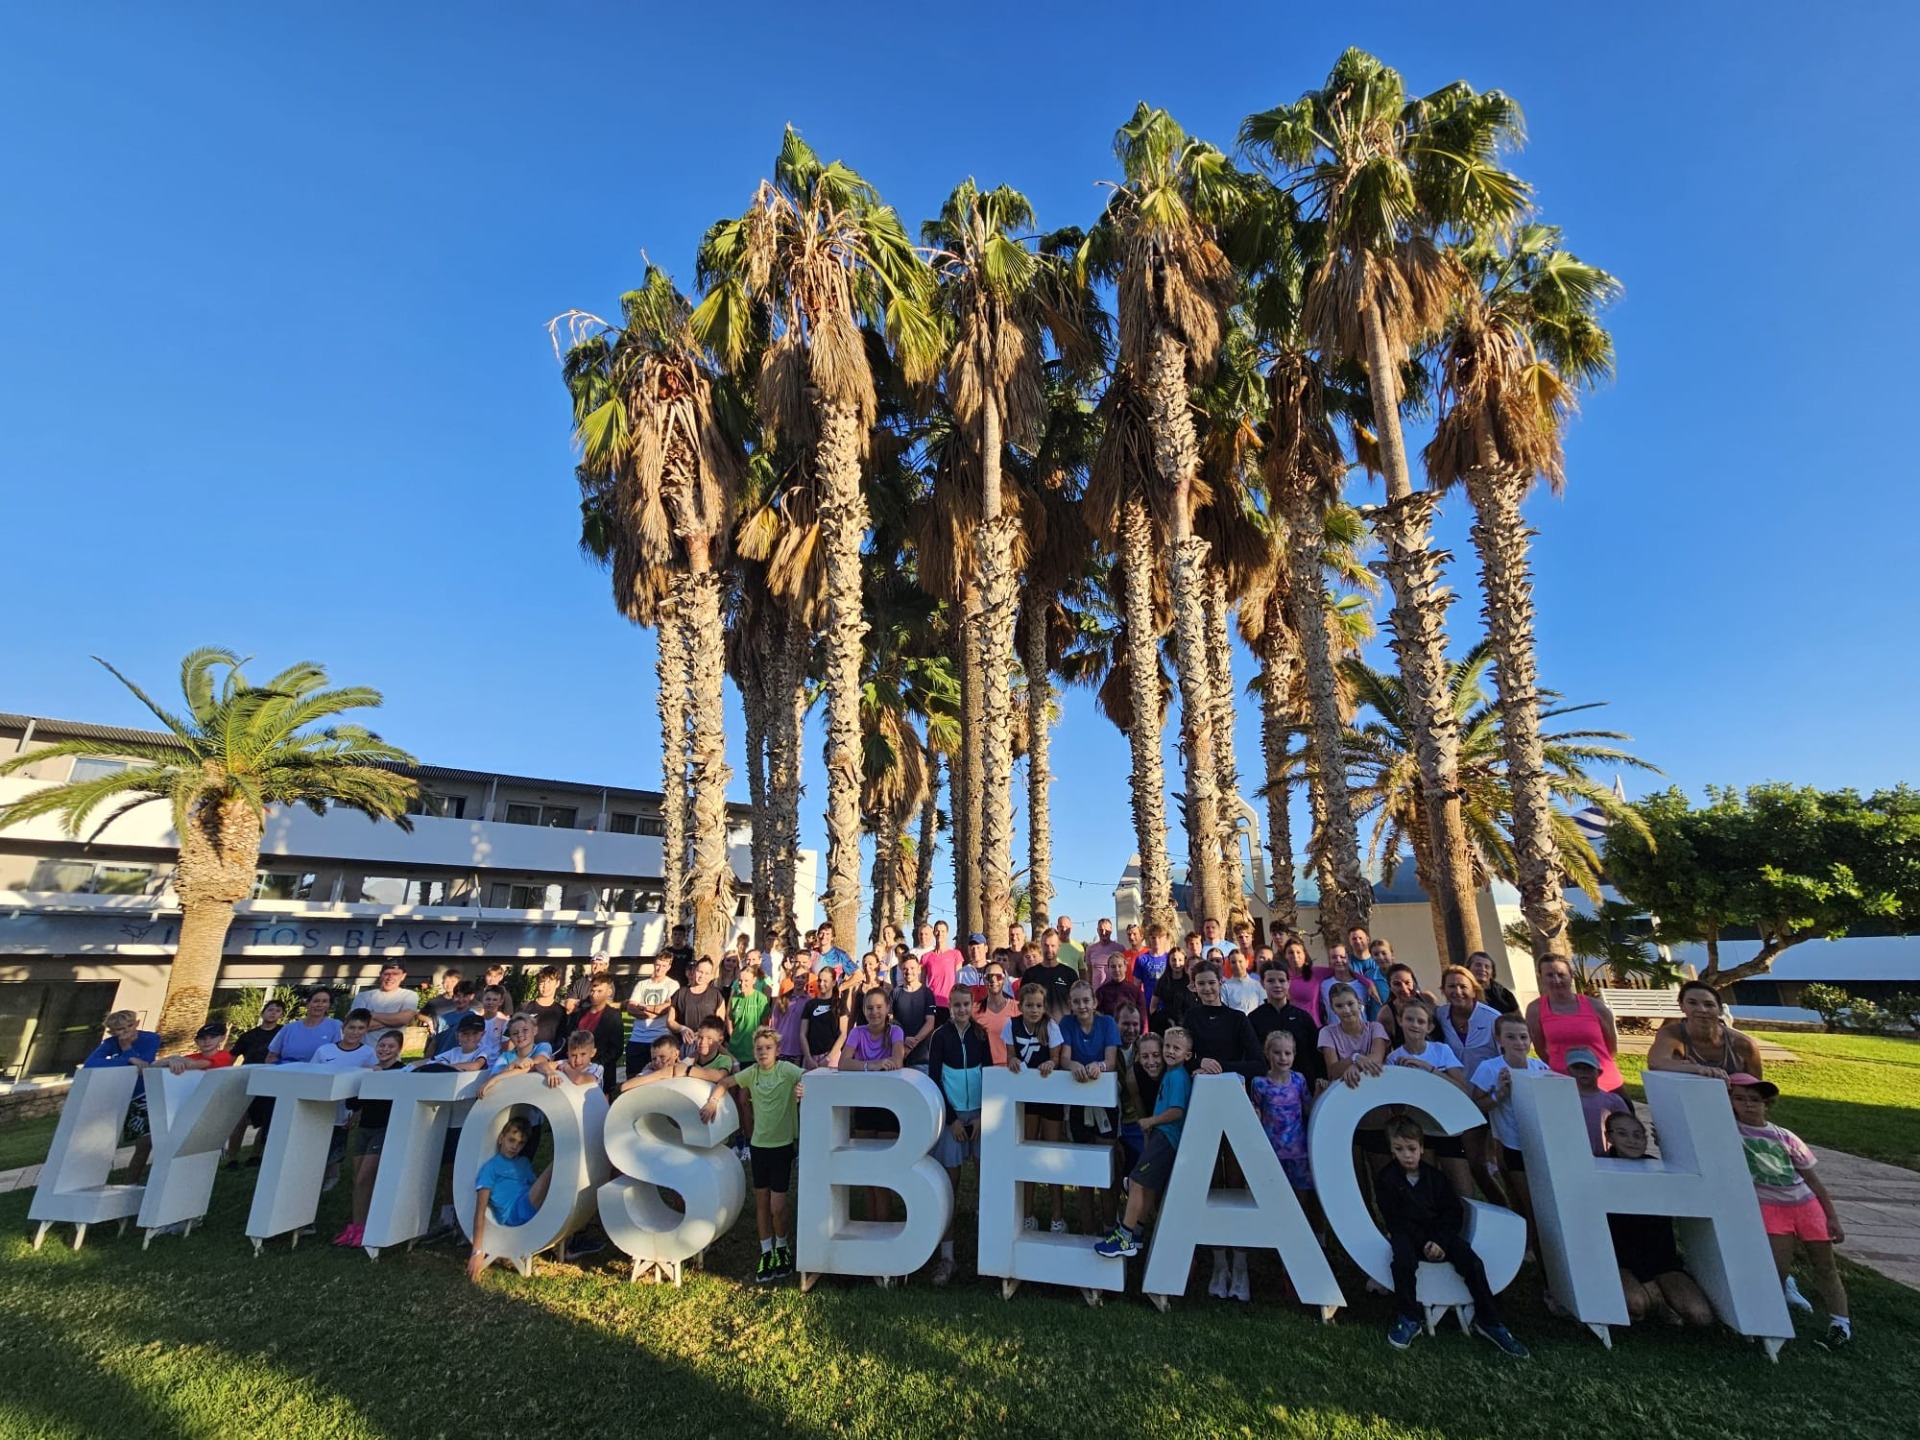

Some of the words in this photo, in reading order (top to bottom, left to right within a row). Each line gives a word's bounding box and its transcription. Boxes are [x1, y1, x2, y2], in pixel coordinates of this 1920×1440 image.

[163, 926, 322, 949] LTTOS
[344, 929, 465, 949] BEACH
[28, 1062, 746, 1264] LYTTOS
[796, 1065, 1796, 1340] BEACH
